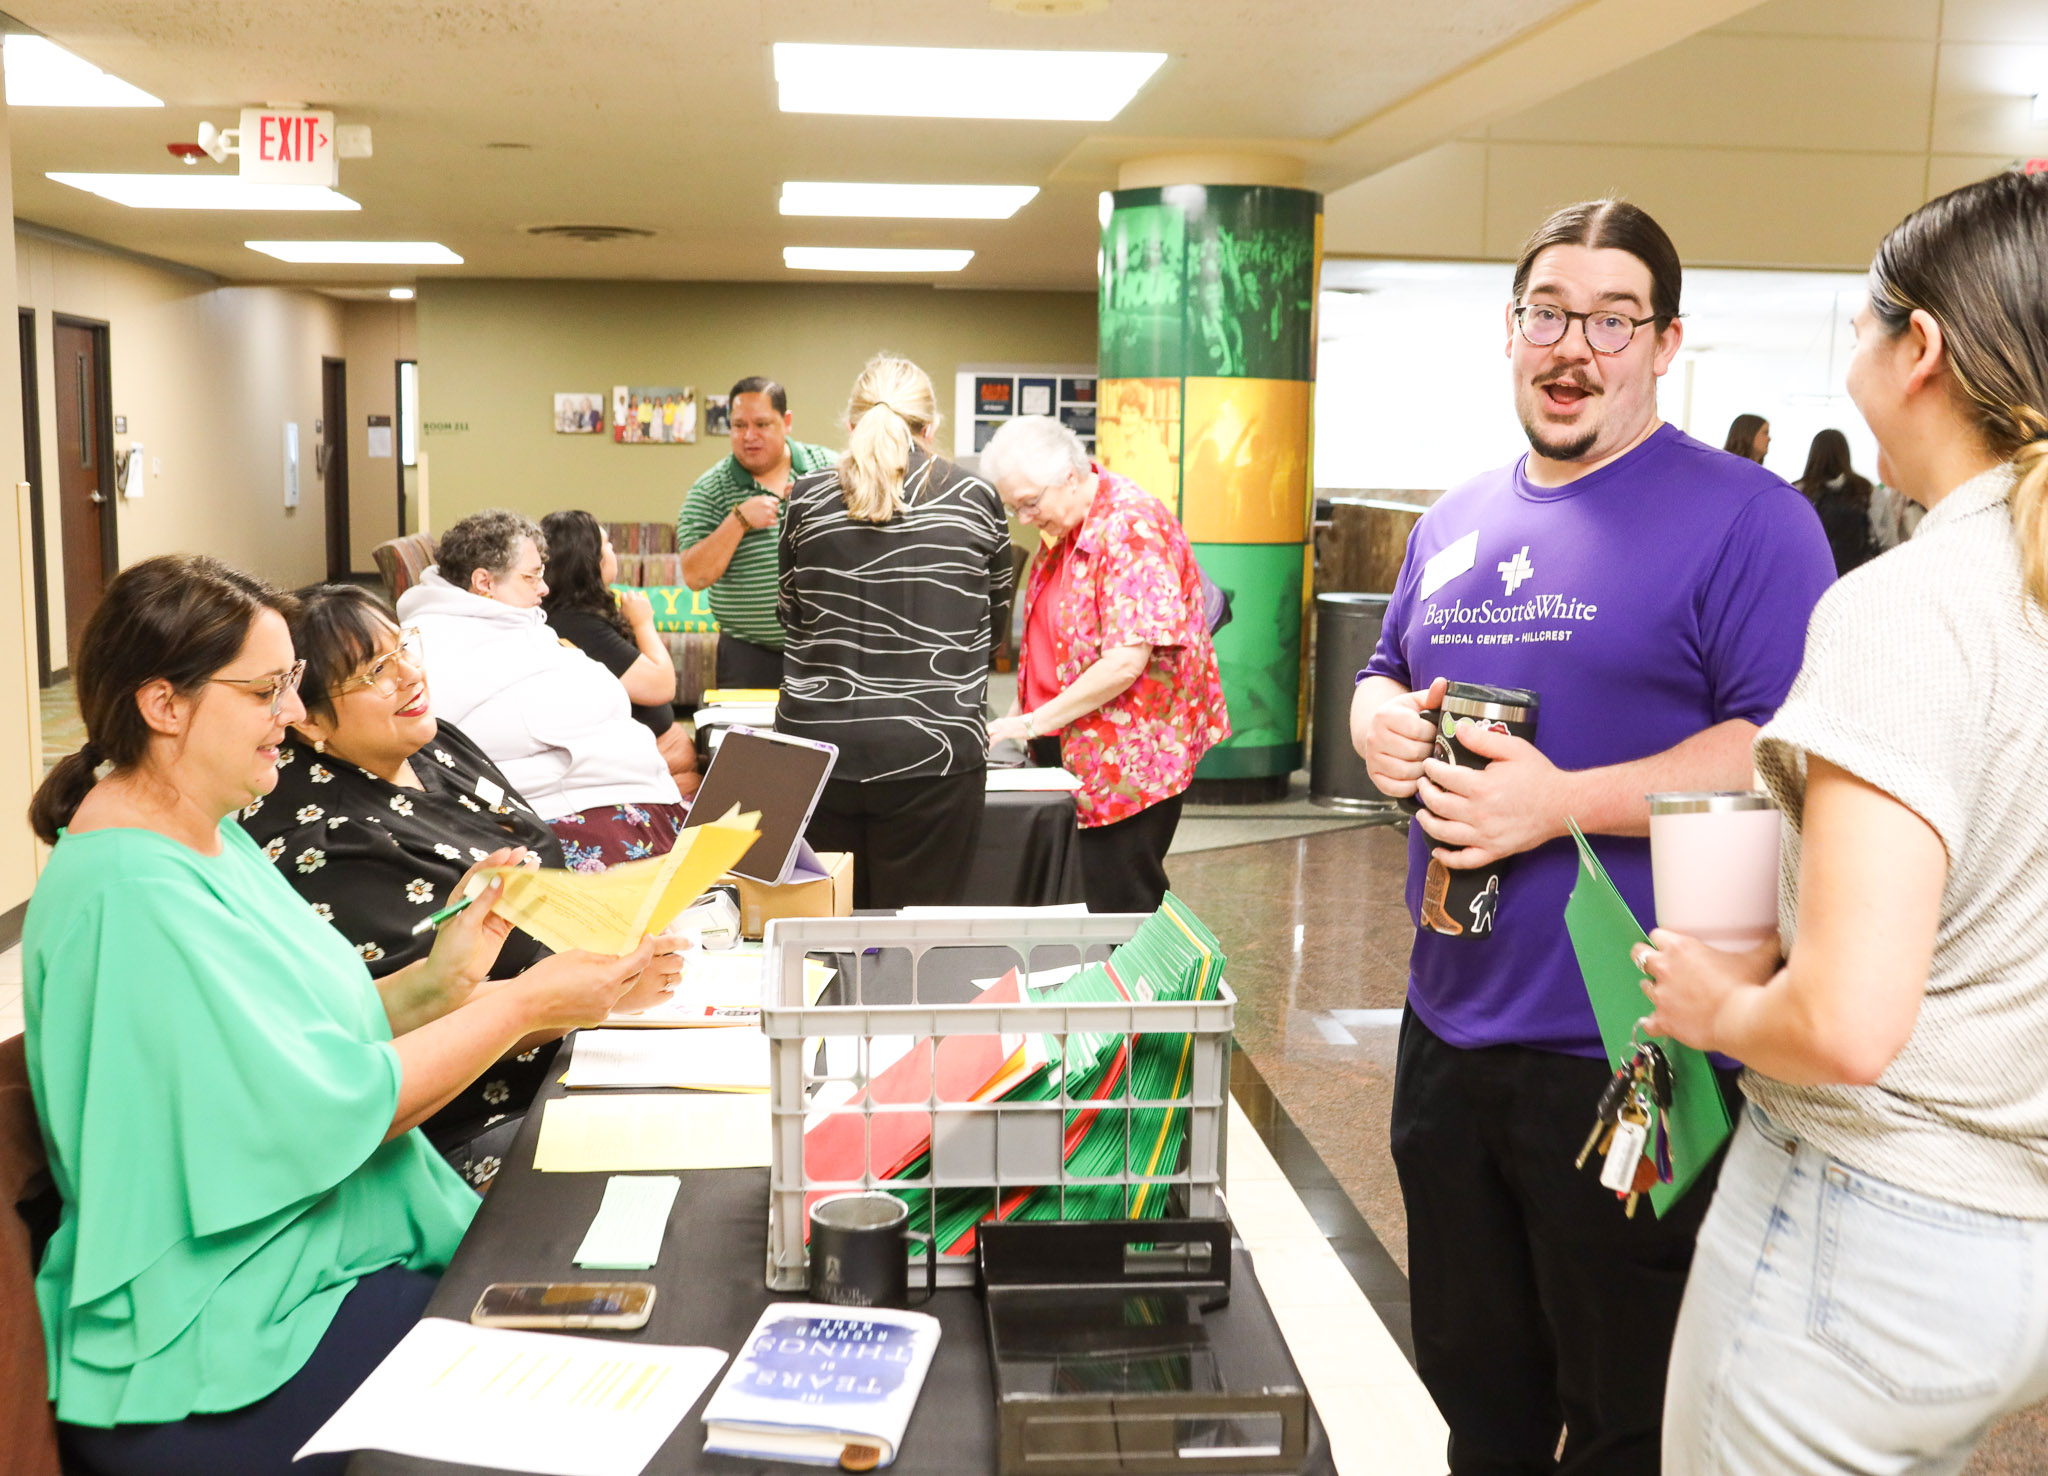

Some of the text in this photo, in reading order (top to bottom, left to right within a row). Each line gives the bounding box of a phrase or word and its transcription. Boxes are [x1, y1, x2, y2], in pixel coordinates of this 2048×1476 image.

[260, 116, 319, 162] EXIT
[1430, 633, 1474, 645] MEDICAL
[1476, 633, 1513, 645] CENTER
[1521, 630, 1573, 644] HILLCREST
[796, 1326, 888, 1342] RICHARD
[755, 1369, 882, 1395] TEARS
